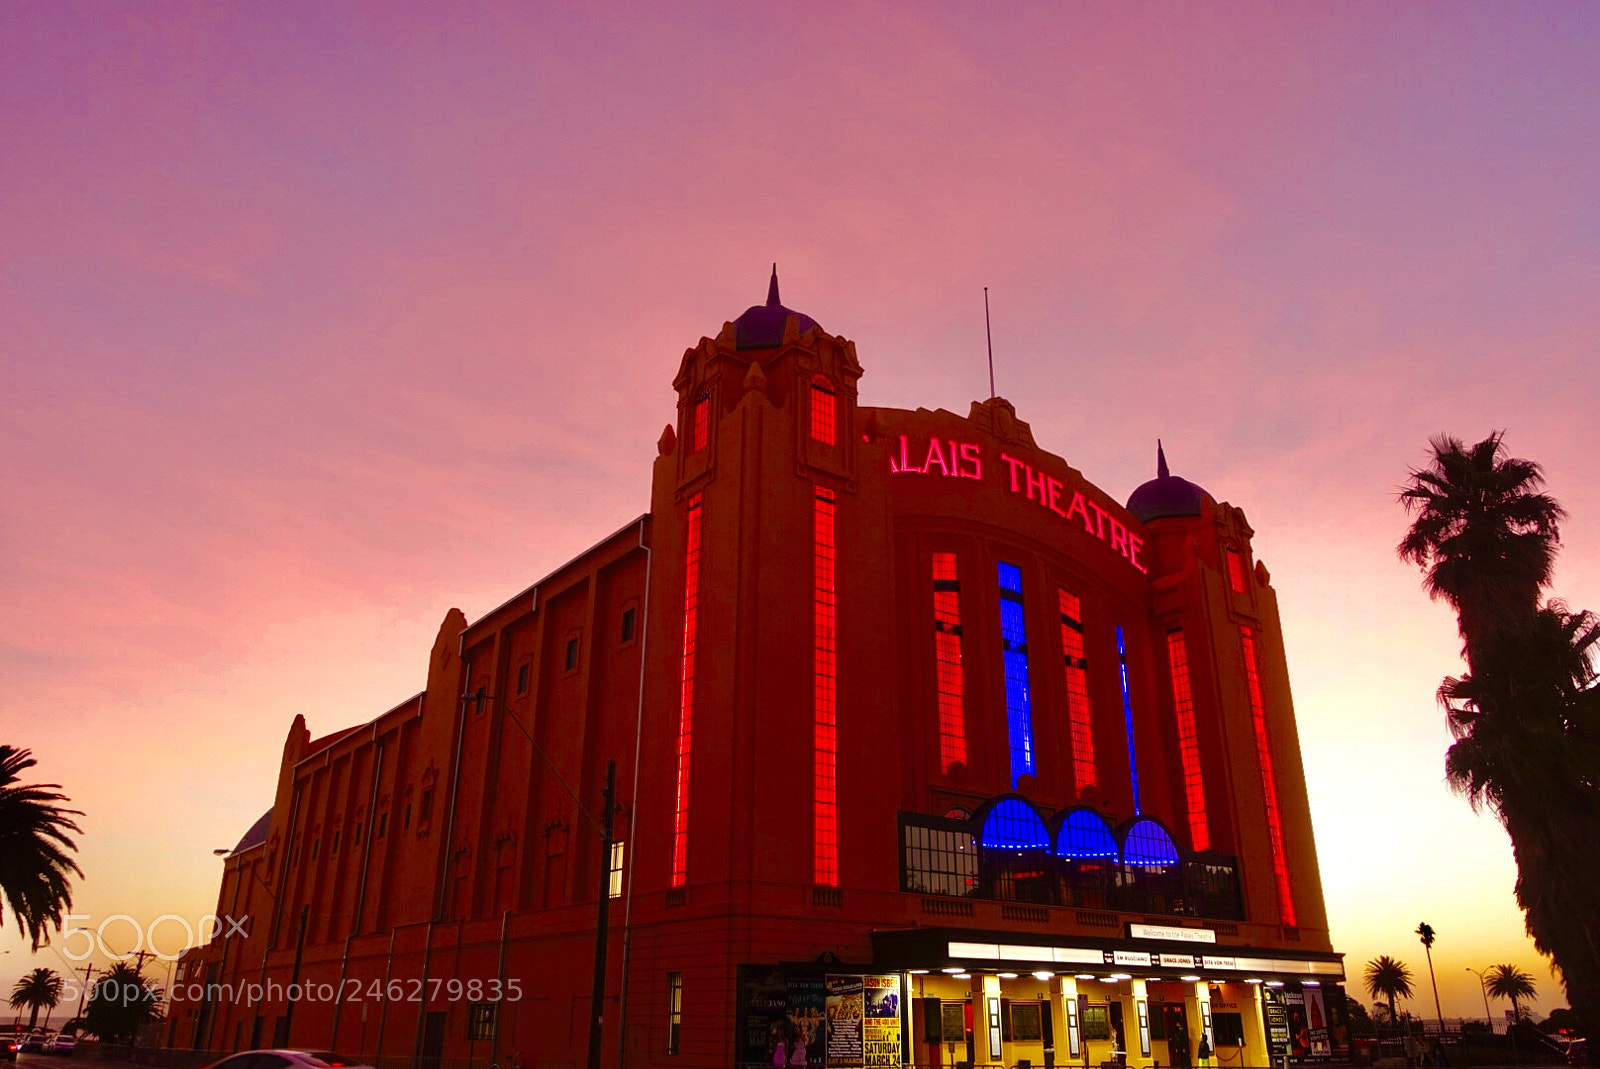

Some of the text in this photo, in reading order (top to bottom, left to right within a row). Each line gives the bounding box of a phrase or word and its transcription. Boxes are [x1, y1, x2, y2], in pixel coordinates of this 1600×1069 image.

[1002, 452, 1147, 574] THEATRE
[1143, 928, 1165, 937] Welcome
[1172, 930, 1180, 938] the
[1181, 931, 1194, 939] Palais
[1195, 932, 1212, 941] Theatre
[873, 1018, 881, 1026] THE
[864, 1042, 900, 1054] SATURDAY
[864, 1055, 901, 1067] MARCH 24
